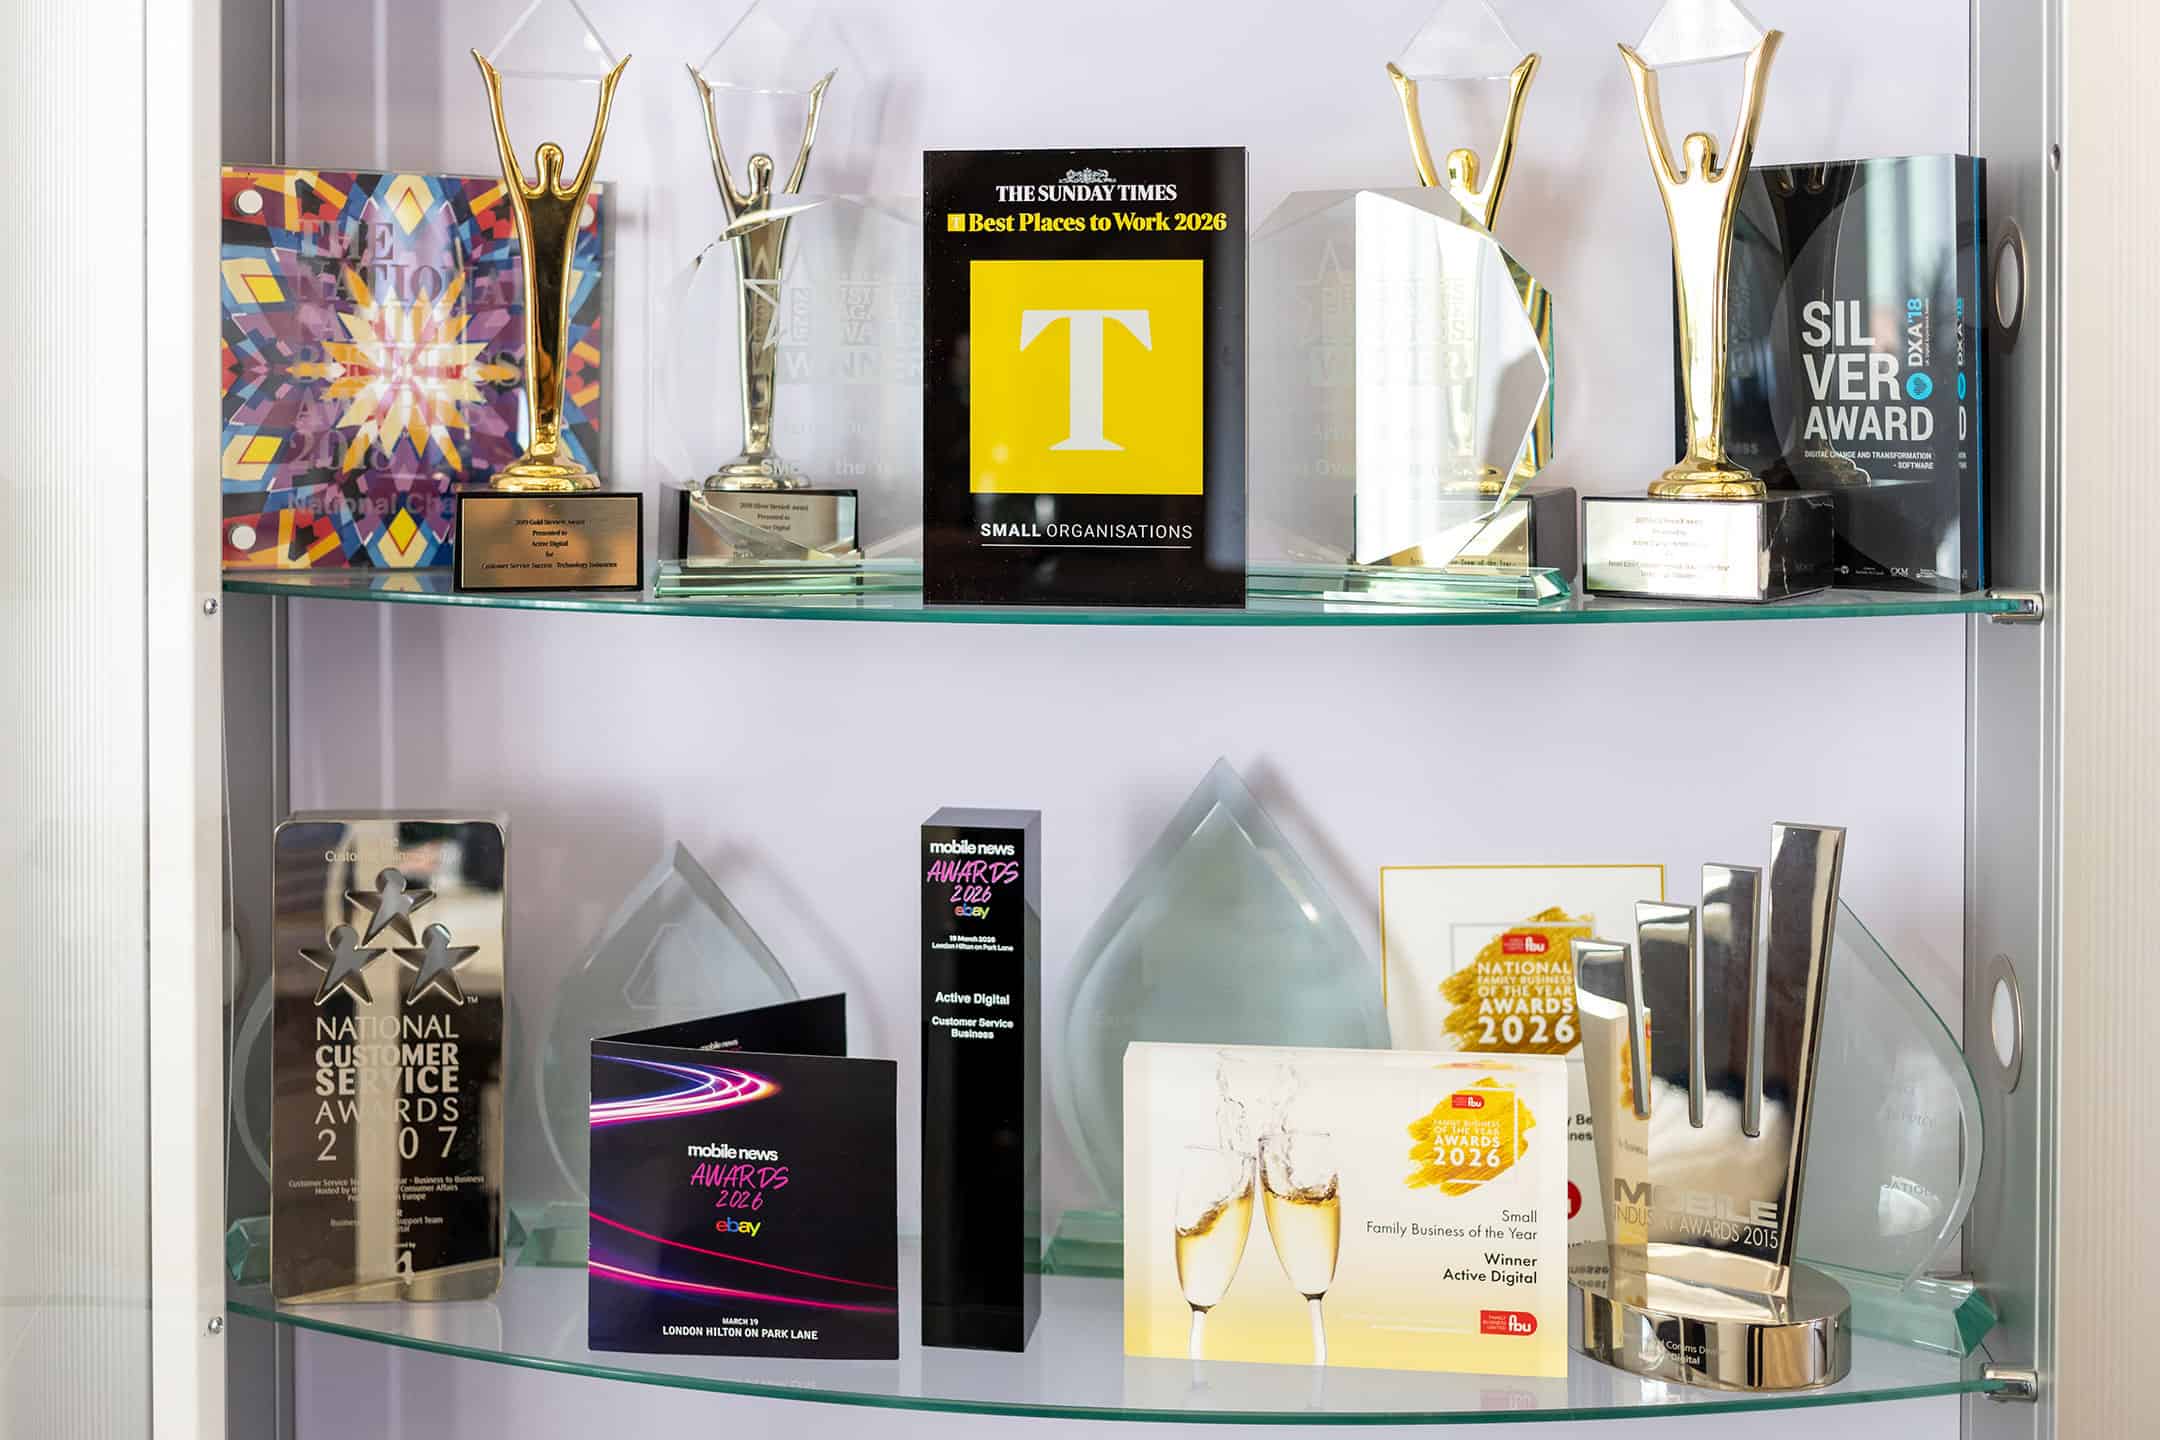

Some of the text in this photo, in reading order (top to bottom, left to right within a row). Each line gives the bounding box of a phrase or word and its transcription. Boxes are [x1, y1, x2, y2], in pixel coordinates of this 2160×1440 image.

[996, 183, 1178, 202] THE SUNDAY TIMES
[968, 214, 1015, 232] Best
[1019, 213, 1087, 231] Places
[1090, 214, 1112, 231] to
[1113, 212, 1171, 231] Work
[1174, 212, 1228, 231] 2026
[1802, 300, 1876, 348] SIL
[1019, 309, 1153, 452] T
[1803, 353, 1901, 401] VER
[1803, 406, 1934, 441] AWARD
[1804, 450, 1829, 459] DIGITAL
[1857, 451, 1872, 459] AND
[1872, 451, 1932, 459] TRANSFORMATION
[1898, 461, 1934, 470] SOFTWARE
[980, 523, 1193, 540] SMALL ORGANISATIONS
[930, 839, 1015, 856] mobile news
[926, 859, 1019, 884] AWARDS
[950, 884, 992, 903] 2026
[954, 900, 990, 920] ebay
[1477, 960, 1572, 975] NATIONAL
[935, 991, 1010, 1008] Active Digital
[1477, 984, 1574, 997] OF THE YEAR
[1480, 997, 1574, 1015] AWARDS
[316, 1014, 460, 1041] NATIONAL
[931, 1015, 1014, 1029] Customer Service
[1478, 1015, 1576, 1045] 2026
[951, 1027, 995, 1040] Business
[315, 1043, 460, 1068] CUSTOMER
[315, 1097, 460, 1125] AWRDS
[317, 1126, 458, 1161] 207
[1434, 1135, 1501, 1147] AWARDS
[687, 1143, 779, 1161] mobile news
[1432, 1147, 1502, 1168] 2026
[690, 1162, 789, 1190] AWARDS
[715, 1189, 764, 1211] 2026
[1502, 1209, 1537, 1223] Small
[715, 1216, 761, 1237] ebay
[1366, 1221, 1537, 1240] Family Business of the Year
[1679, 1215, 1740, 1243] AWARDS
[1743, 1226, 1779, 1249] 2015
[1484, 1252, 1538, 1267] Winner
[1442, 1268, 1537, 1286] Active Digital
[722, 1317, 759, 1326] MARCH 19
[1508, 1314, 1532, 1332] fbu
[662, 1325, 819, 1340] LONDON HILTON ON PARK LANE
